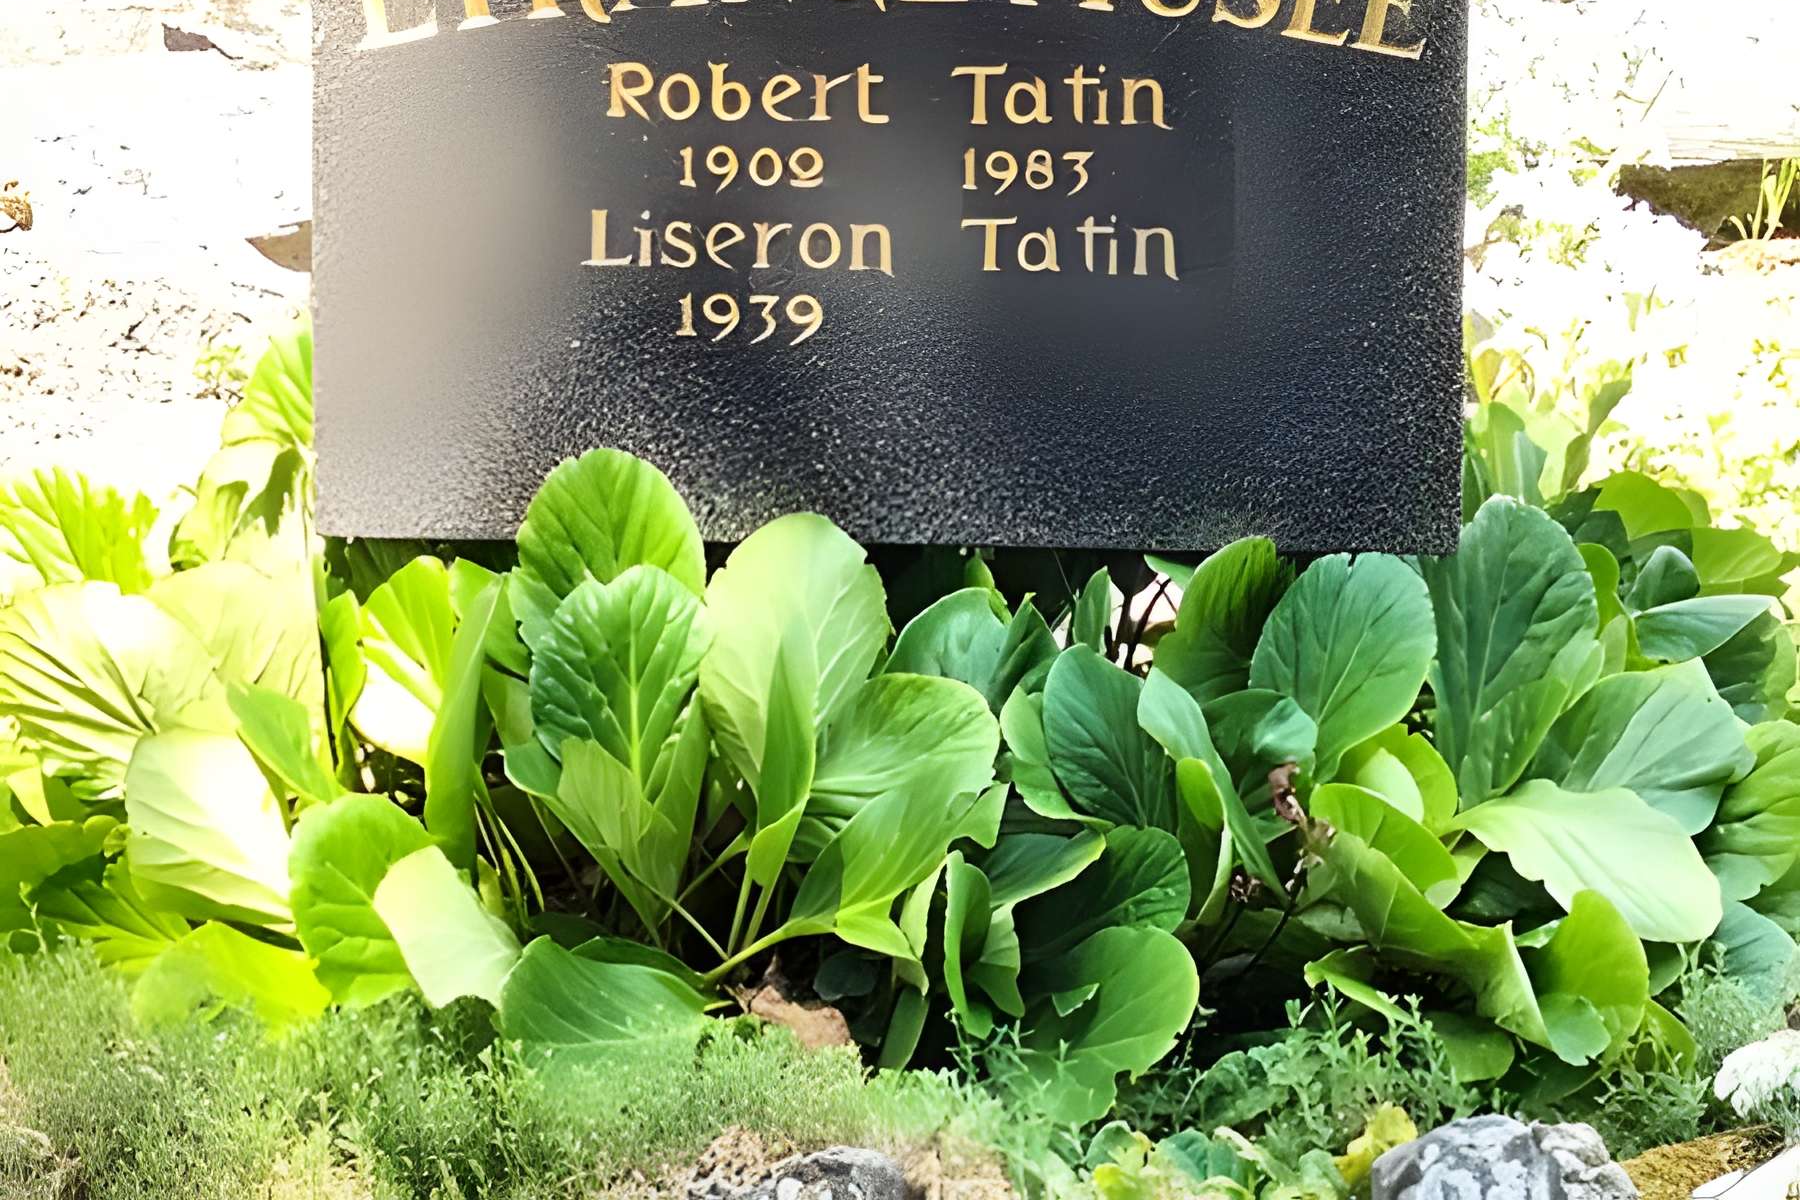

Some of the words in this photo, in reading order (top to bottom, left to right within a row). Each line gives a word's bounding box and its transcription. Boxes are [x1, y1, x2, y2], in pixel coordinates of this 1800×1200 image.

[605, 60, 890, 126] Robert
[950, 63, 1173, 130] Tatin
[962, 146, 1094, 196] 1983
[580, 208, 895, 277] Liseron
[961, 214, 1179, 281] Tatin
[675, 292, 823, 345] 1939
